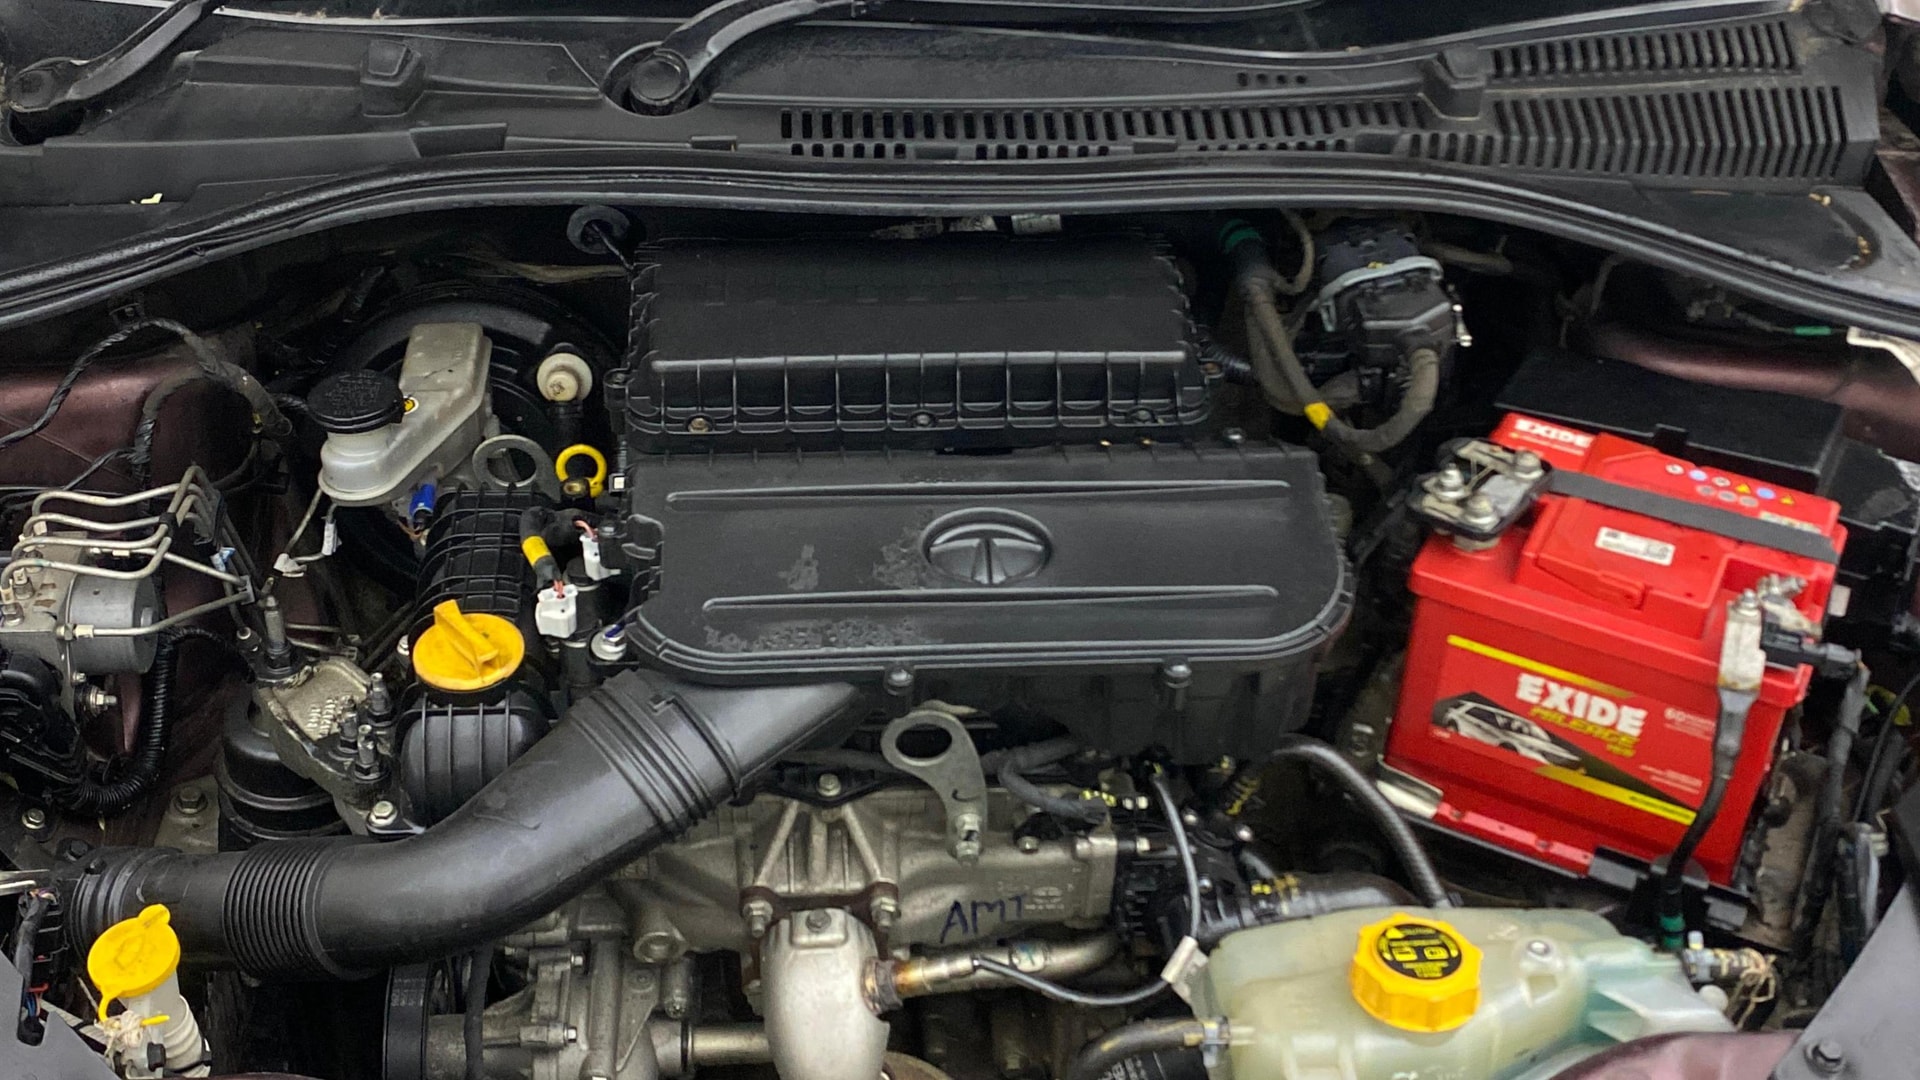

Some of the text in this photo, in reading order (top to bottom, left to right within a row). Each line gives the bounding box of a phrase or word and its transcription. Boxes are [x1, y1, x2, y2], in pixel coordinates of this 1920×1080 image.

[1514, 418, 1595, 448] EXIDE
[1515, 672, 1648, 737] EXIDE
[939, 893, 1027, 944] AMT
